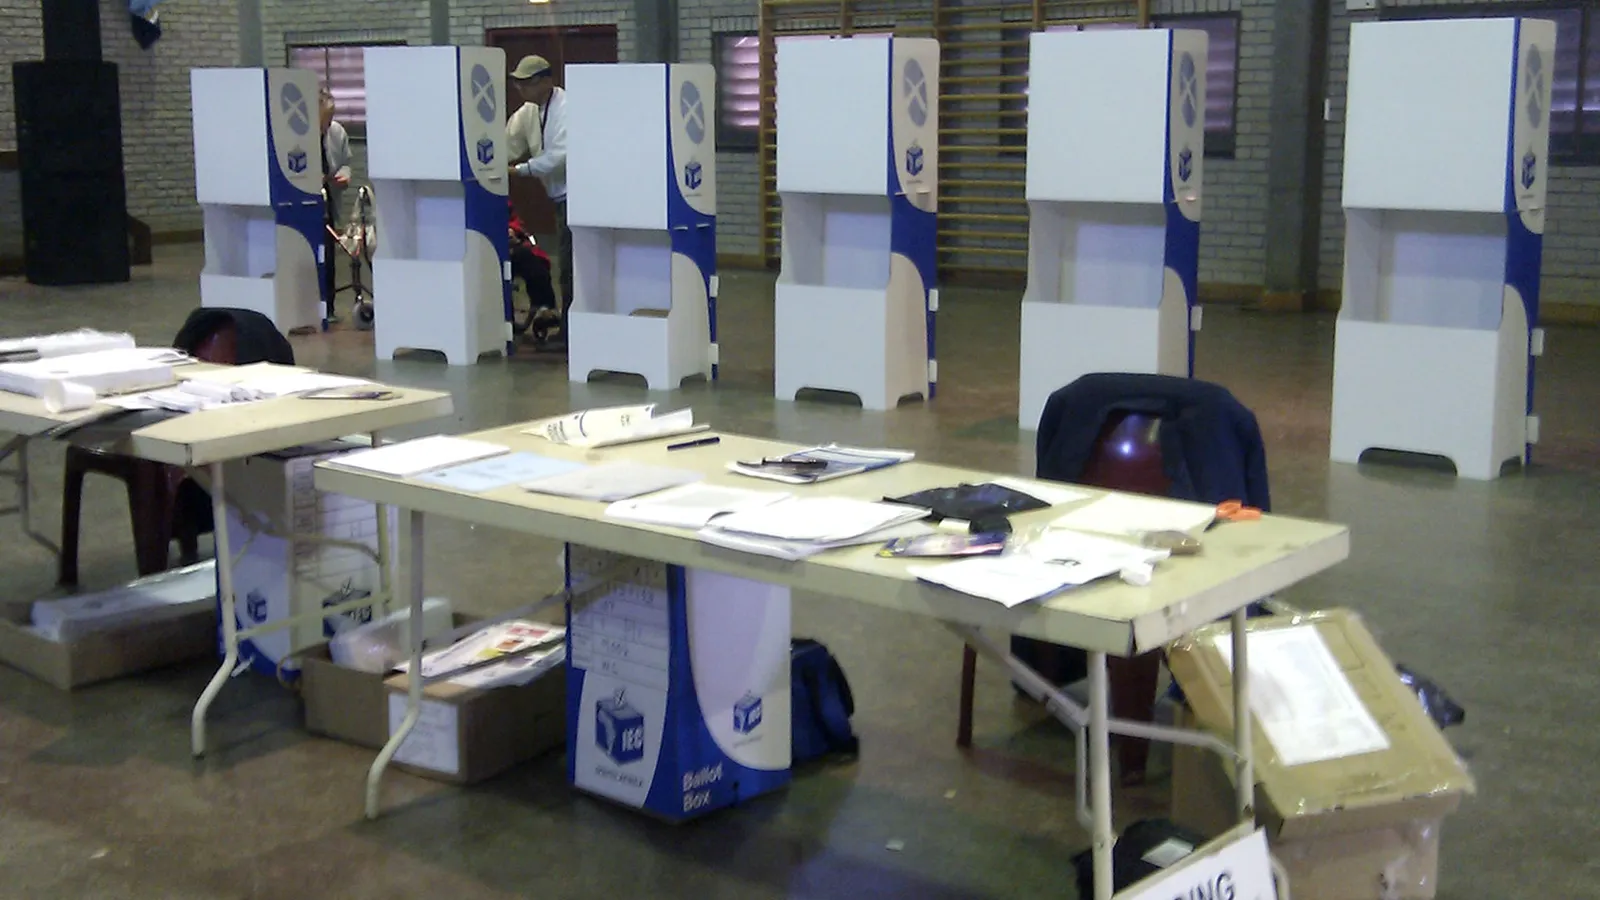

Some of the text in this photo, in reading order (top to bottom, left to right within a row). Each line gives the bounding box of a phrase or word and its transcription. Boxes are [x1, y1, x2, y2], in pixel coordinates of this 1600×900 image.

[621, 725, 644, 752] IEC
[683, 761, 723, 792] Ballot
[683, 789, 711, 812] Box
